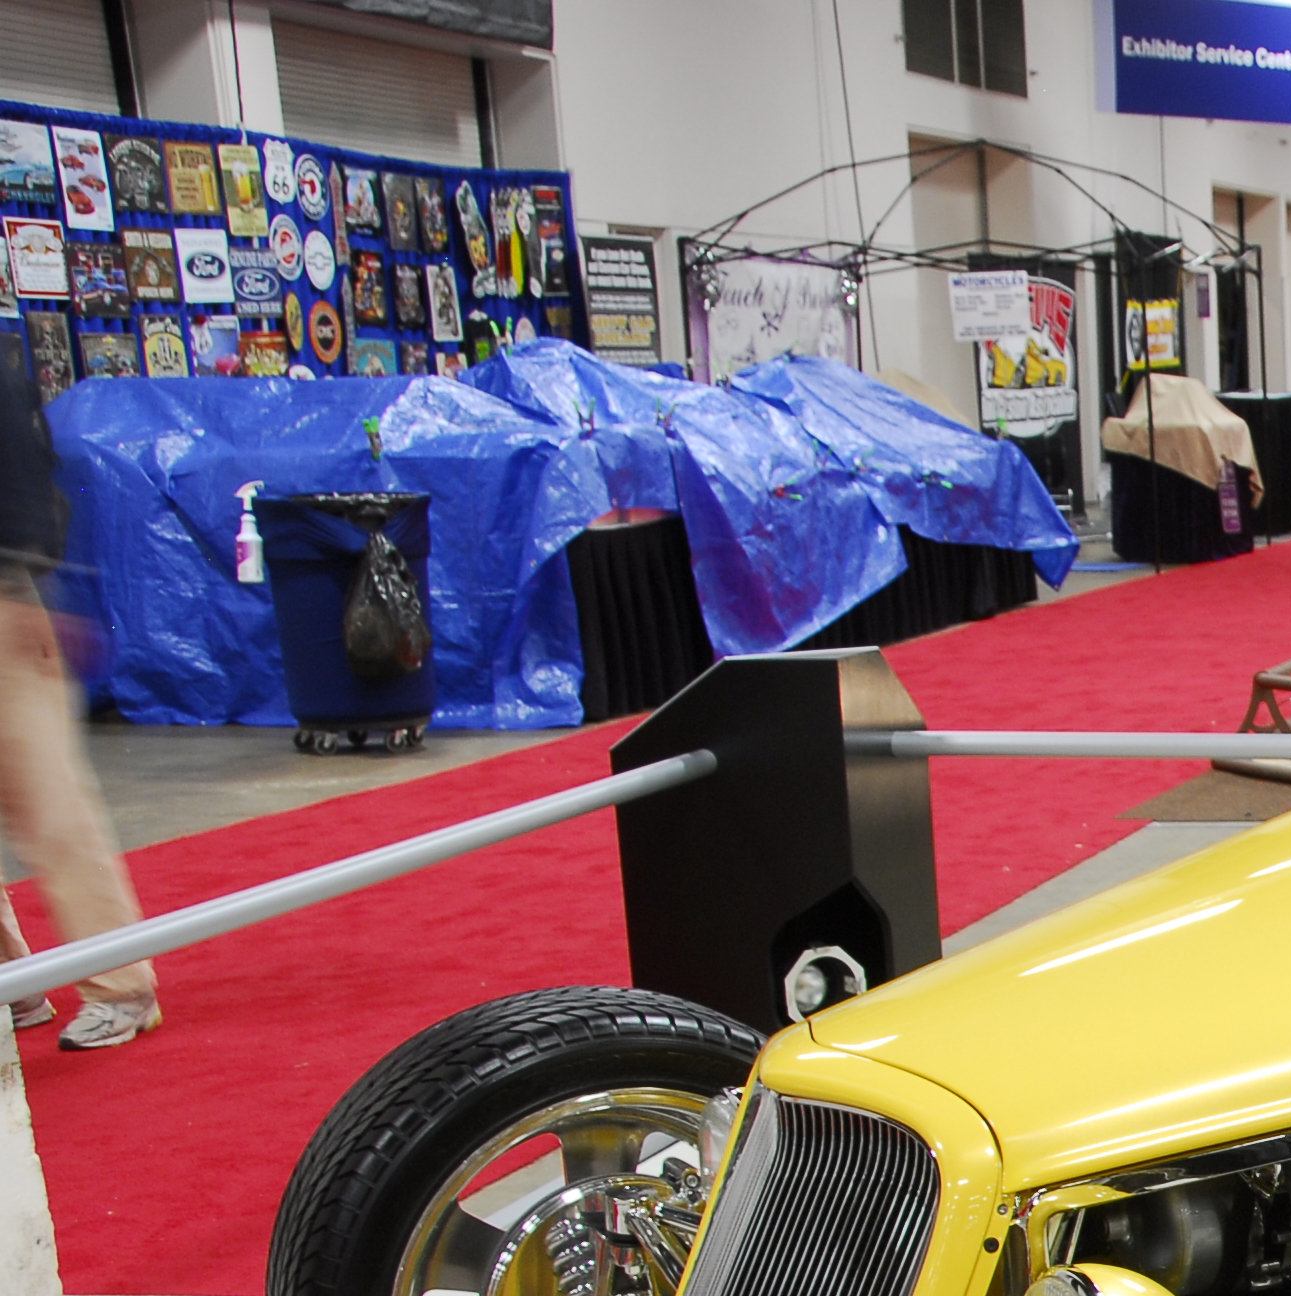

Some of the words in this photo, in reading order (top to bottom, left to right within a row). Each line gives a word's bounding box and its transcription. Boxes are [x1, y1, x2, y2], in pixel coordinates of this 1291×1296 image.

[1122, 36, 1193, 61] Exhibitor
[1196, 42, 1254, 67] Service
[273, 175, 290, 195] 66
[193, 254, 220, 277] Ford
[242, 272, 271, 295] Ford
[953, 277, 1024, 287] MOTORCYCLES
